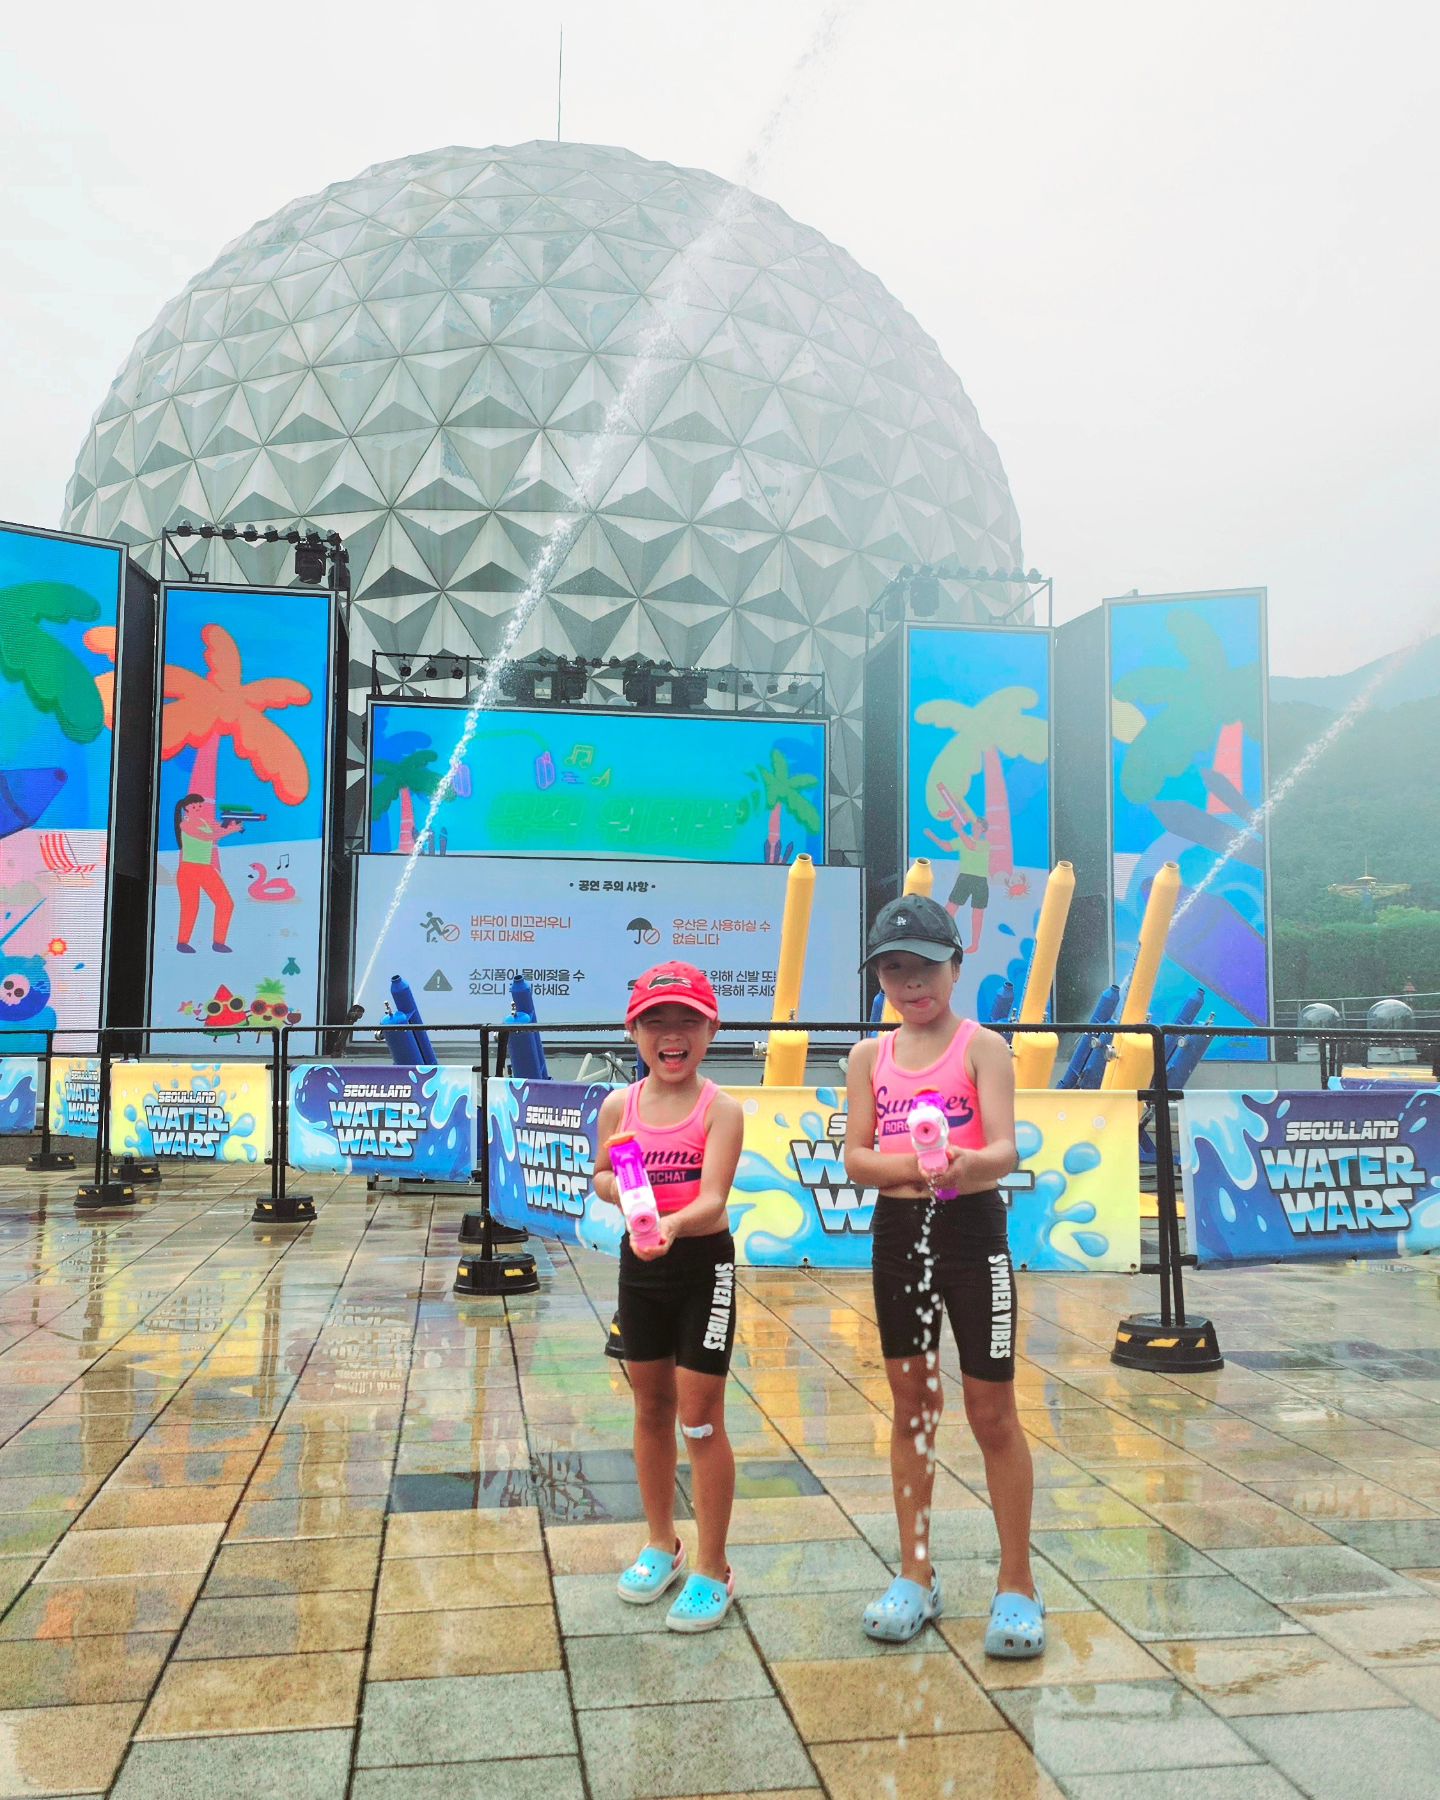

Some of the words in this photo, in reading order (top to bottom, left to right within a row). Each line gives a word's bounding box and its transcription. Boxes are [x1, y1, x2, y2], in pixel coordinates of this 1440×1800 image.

[578, 880, 600, 892] 공연
[602, 881, 624, 892] 주의
[626, 881, 649, 893] 사항
[471, 915, 507, 928] 바닥이
[511, 916, 571, 928] 미끄러우니
[672, 918, 708, 931] 우산은
[711, 919, 757, 932] 사용하실
[759, 920, 771, 932] 수
[470, 930, 495, 942] 뛰지
[498, 930, 535, 942] 마세요
[672, 933, 720, 945] 없습니다
[469, 968, 519, 981] 소지품이
[573, 969, 586, 982] 수
[710, 970, 733, 983] 위해
[736, 970, 759, 983] 신발
[469, 983, 506, 996] 있으니
[510, 983, 570, 996] 하세요
[158, 1090, 216, 1104] SEOULLAND
[343, 1084, 412, 1099] SEOULLAND
[68, 1102, 100, 1123] WARS
[145, 1105, 230, 1133] WATER
[328, 1100, 427, 1129] WATER
[526, 1105, 581, 1129] SEOULLAND
[1285, 1120, 1400, 1142] SEOULLAND
[152, 1131, 220, 1157] WARS
[337, 1128, 417, 1158] WARS
[515, 1127, 596, 1176] WATER
[1259, 1146, 1427, 1190] WATER
[523, 1167, 588, 1217] WARS
[1279, 1188, 1414, 1235] WARS
[702, 1307, 731, 1351] VIBES
[990, 1311, 1012, 1359] VIBES
